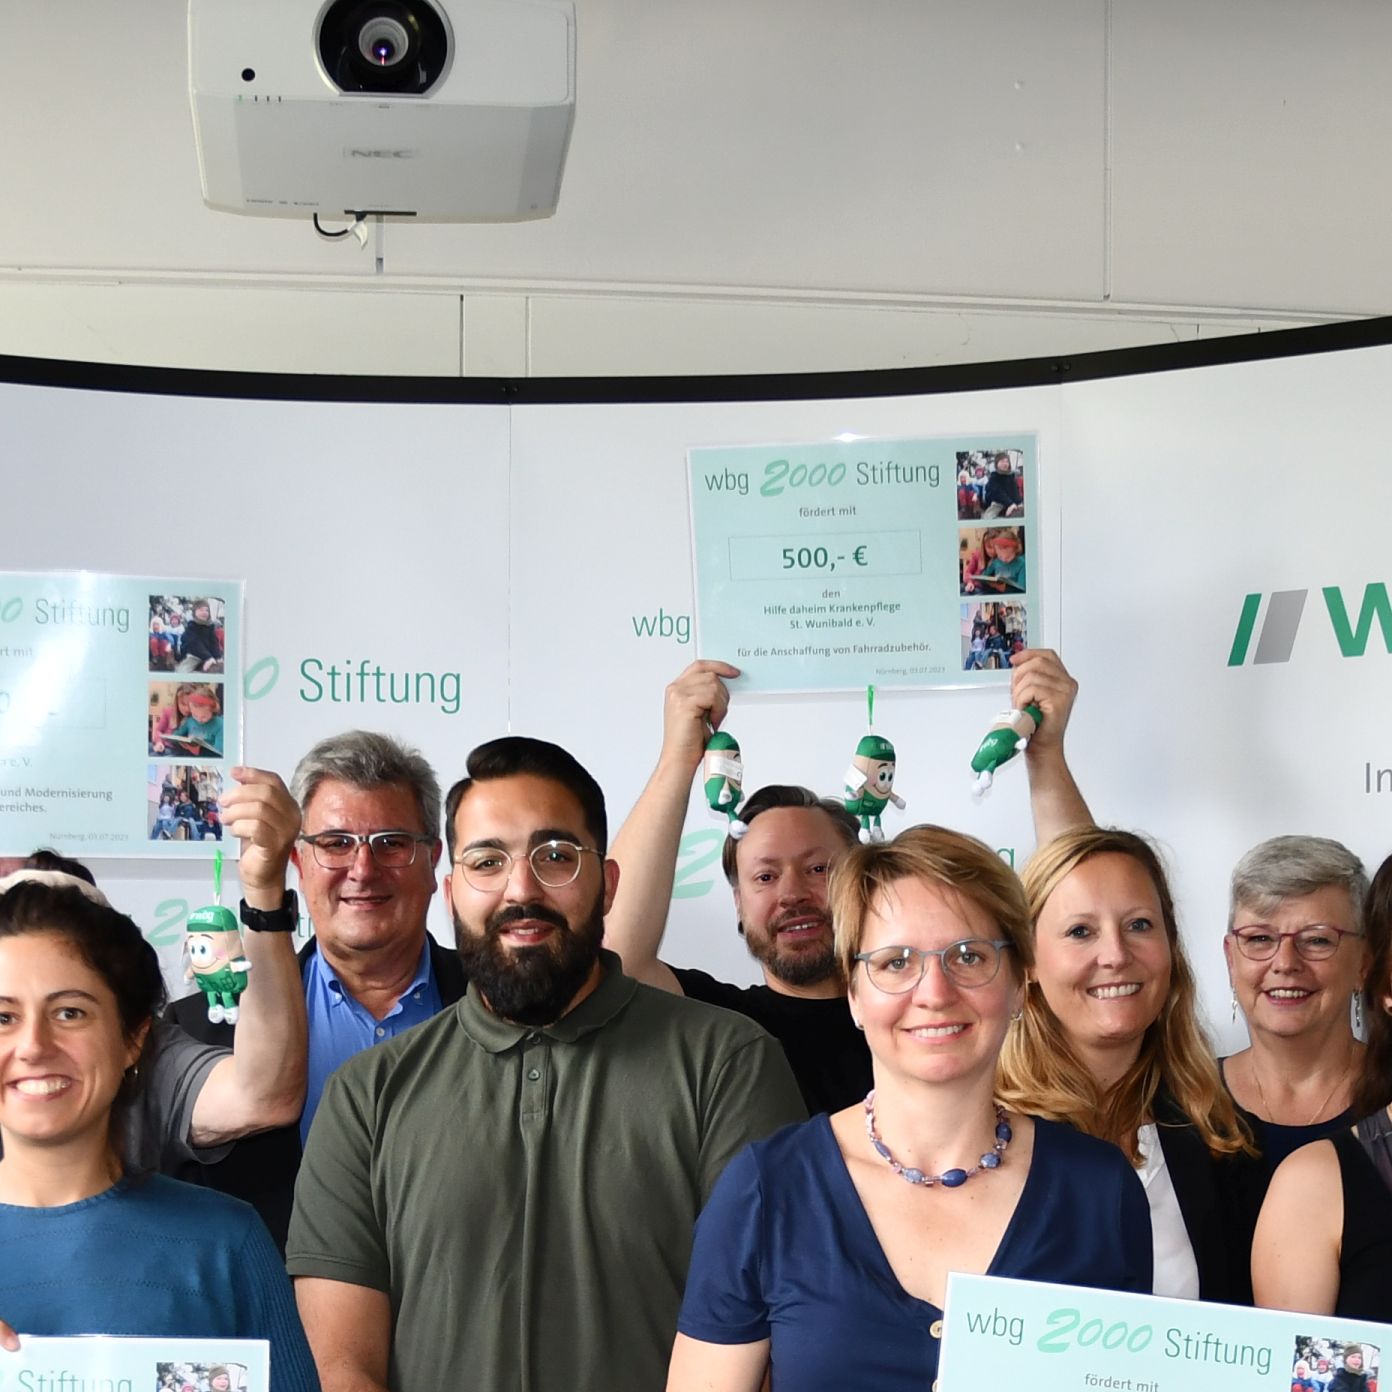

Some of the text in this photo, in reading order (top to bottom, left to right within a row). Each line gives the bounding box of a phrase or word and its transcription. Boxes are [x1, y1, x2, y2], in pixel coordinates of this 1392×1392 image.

[705, 459, 940, 496] wbg 2000 Stiftung
[799, 506, 856, 517] fördert mit
[783, 545, 868, 571] 500,- €
[822, 589, 840, 598] den
[35, 598, 130, 633] Stiftung
[764, 602, 900, 615] Hilfe daheim Krankenpflege
[632, 608, 692, 644] wbg
[790, 620, 802, 629] St.
[805, 618, 852, 628] Wunibald
[867, 617, 875, 626] V.
[738, 648, 751, 656] für
[754, 648, 767, 656] die
[771, 646, 830, 657] Anschaffung
[853, 643, 931, 653] Fahrradzubehör.
[299, 656, 462, 713] Stiftung
[0, 787, 21, 797] und
[25, 788, 112, 801] Modernisierung
[966, 1307, 1272, 1375] wbg 2000 Stiftung
[1086, 1373, 1158, 1392] fördert mit
